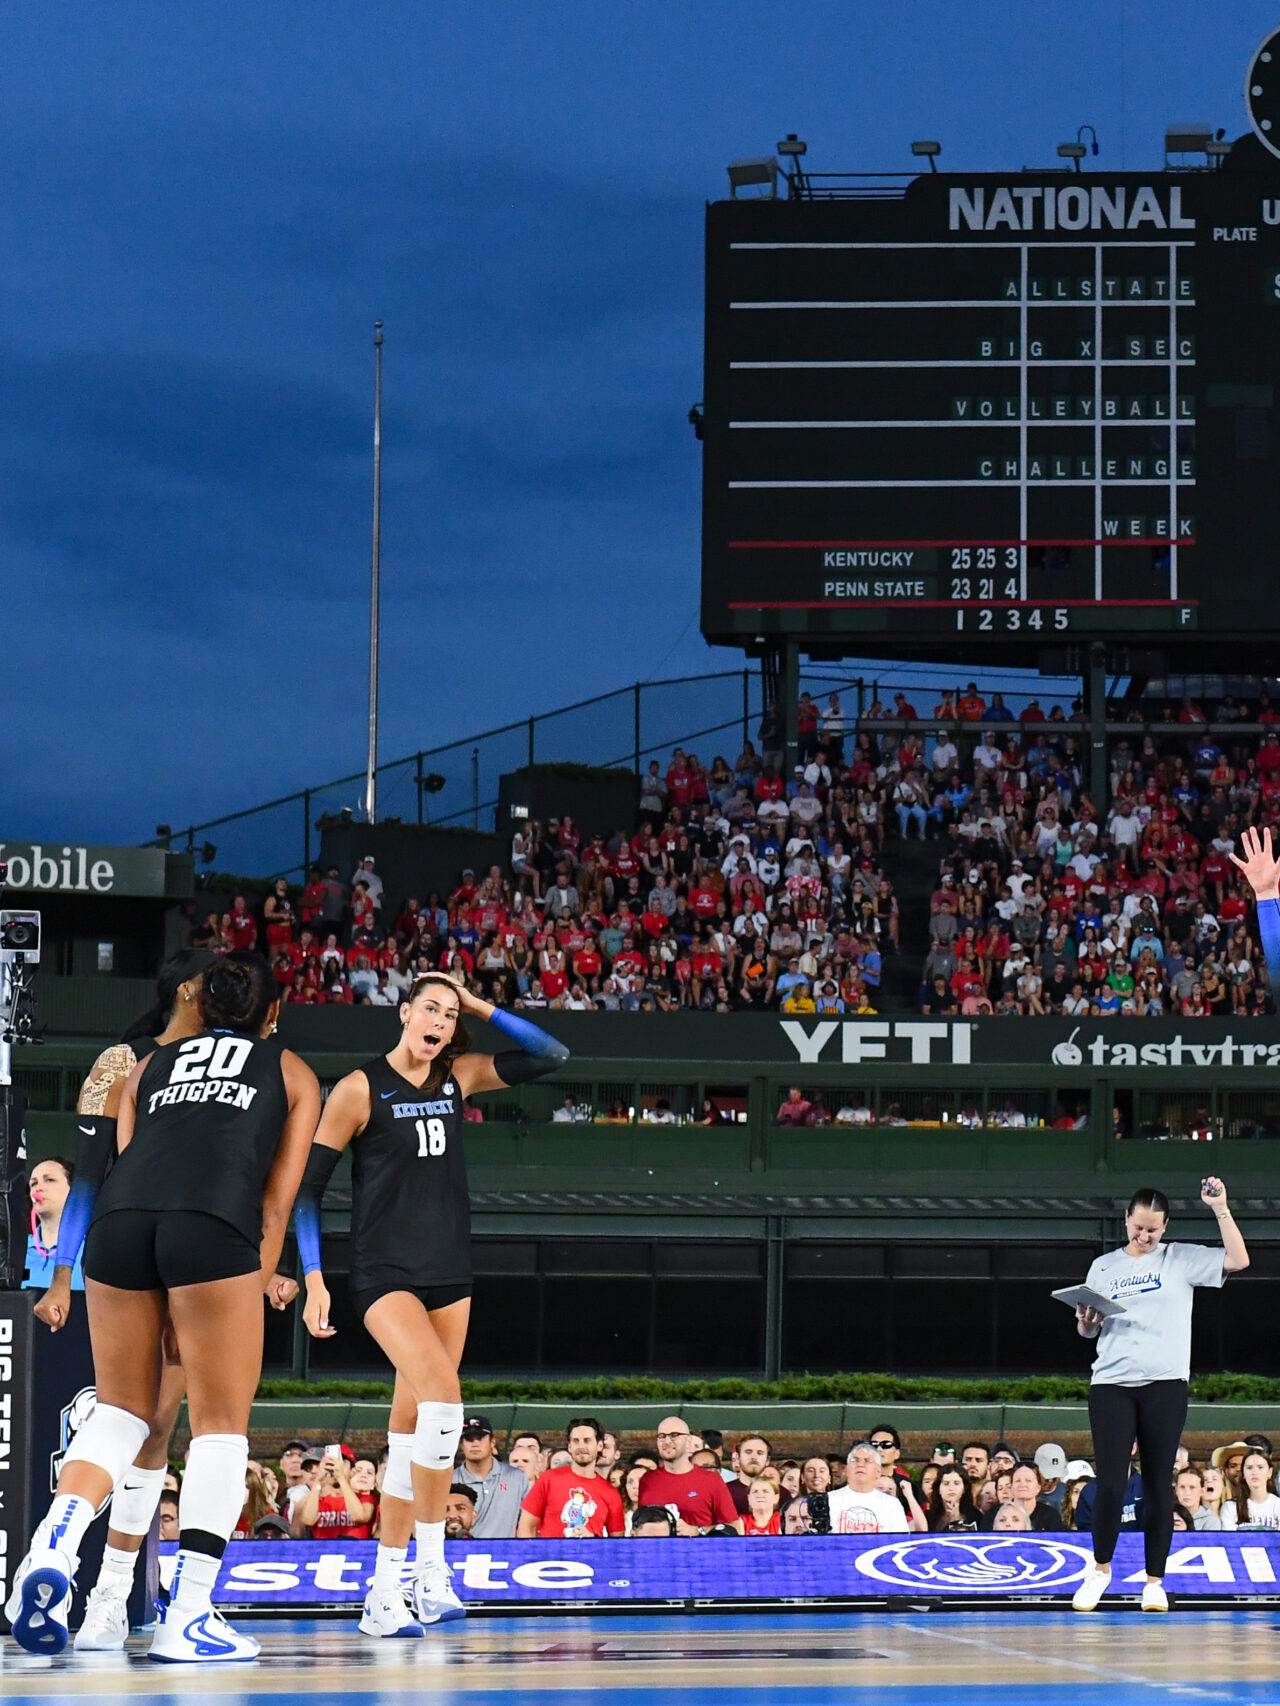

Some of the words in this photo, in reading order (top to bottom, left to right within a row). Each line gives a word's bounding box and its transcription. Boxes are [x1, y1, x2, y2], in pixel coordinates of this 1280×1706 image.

[949, 186, 1196, 231] NATIONAL
[1213, 227, 1257, 242] PLATE
[1007, 280, 1190, 297] ALLSTATE
[981, 340, 1042, 357] BIG
[1081, 340, 1091, 357] X
[1130, 339, 1191, 357] SEC
[956, 400, 1191, 417] VOLLEYBALL
[981, 460, 1191, 477] CHALLENGE
[1104, 519, 1191, 536] WEEK
[824, 551, 914, 567] KENTUCKY
[951, 547, 971, 570] 25
[976, 547, 996, 570] 25
[1004, 547, 1018, 570] 3
[824, 581, 869, 597] PENN
[874, 580, 925, 597] STATE
[951, 578, 971, 600] 23
[979, 578, 994, 600] 21
[1004, 578, 1018, 600] 4
[956, 609, 965, 630] 1
[978, 609, 993, 630] 2
[1006, 609, 1021, 630] 3
[1028, 609, 1043, 630] 4
[1054, 608, 1068, 630] 5
[1181, 608, 1191, 624] F
[0, 845, 115, 891] obile
[779, 1021, 971, 1065] YETI
[168, 1036, 254, 1085] 20
[148, 1079, 258, 1115] THIGPEN
[391, 1099, 455, 1119] KENTUCKY
[415, 1118, 446, 1157] 18
[1109, 1270, 1163, 1292] Kentucky
